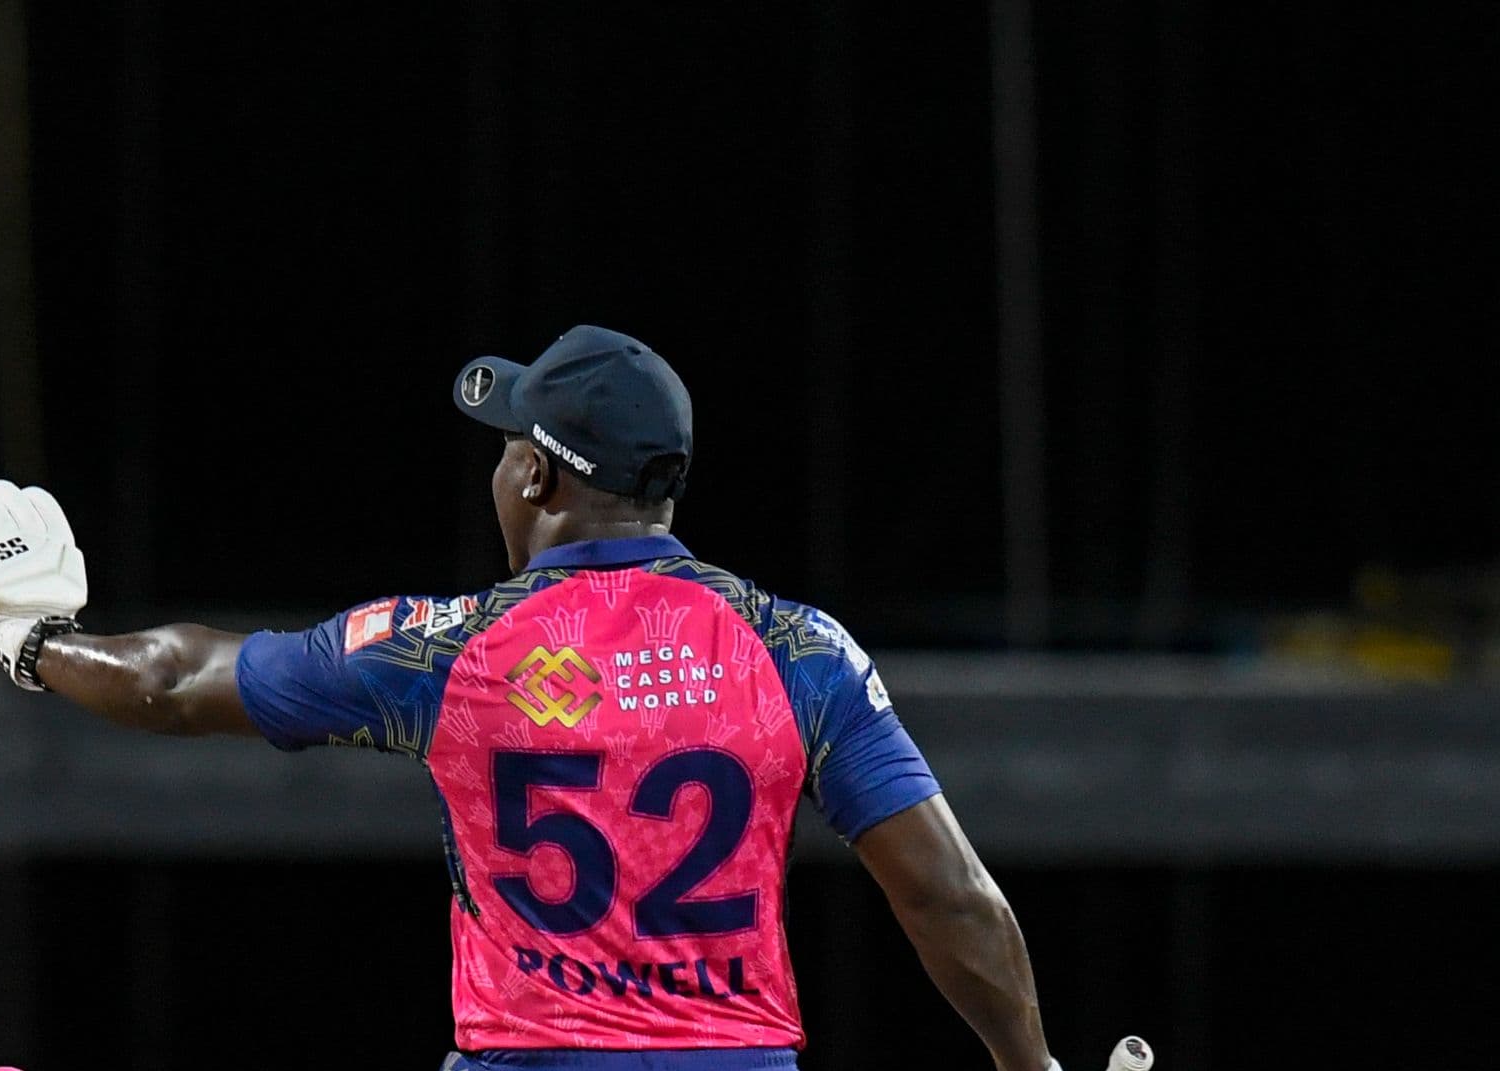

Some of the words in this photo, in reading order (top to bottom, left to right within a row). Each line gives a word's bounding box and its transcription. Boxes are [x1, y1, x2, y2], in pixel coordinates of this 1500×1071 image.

[615, 644, 695, 667] MEGA
[617, 663, 724, 689] CASINO
[618, 688, 717, 711] WORLD
[491, 746, 760, 941] 52
[512, 945, 760, 999] POWELL
